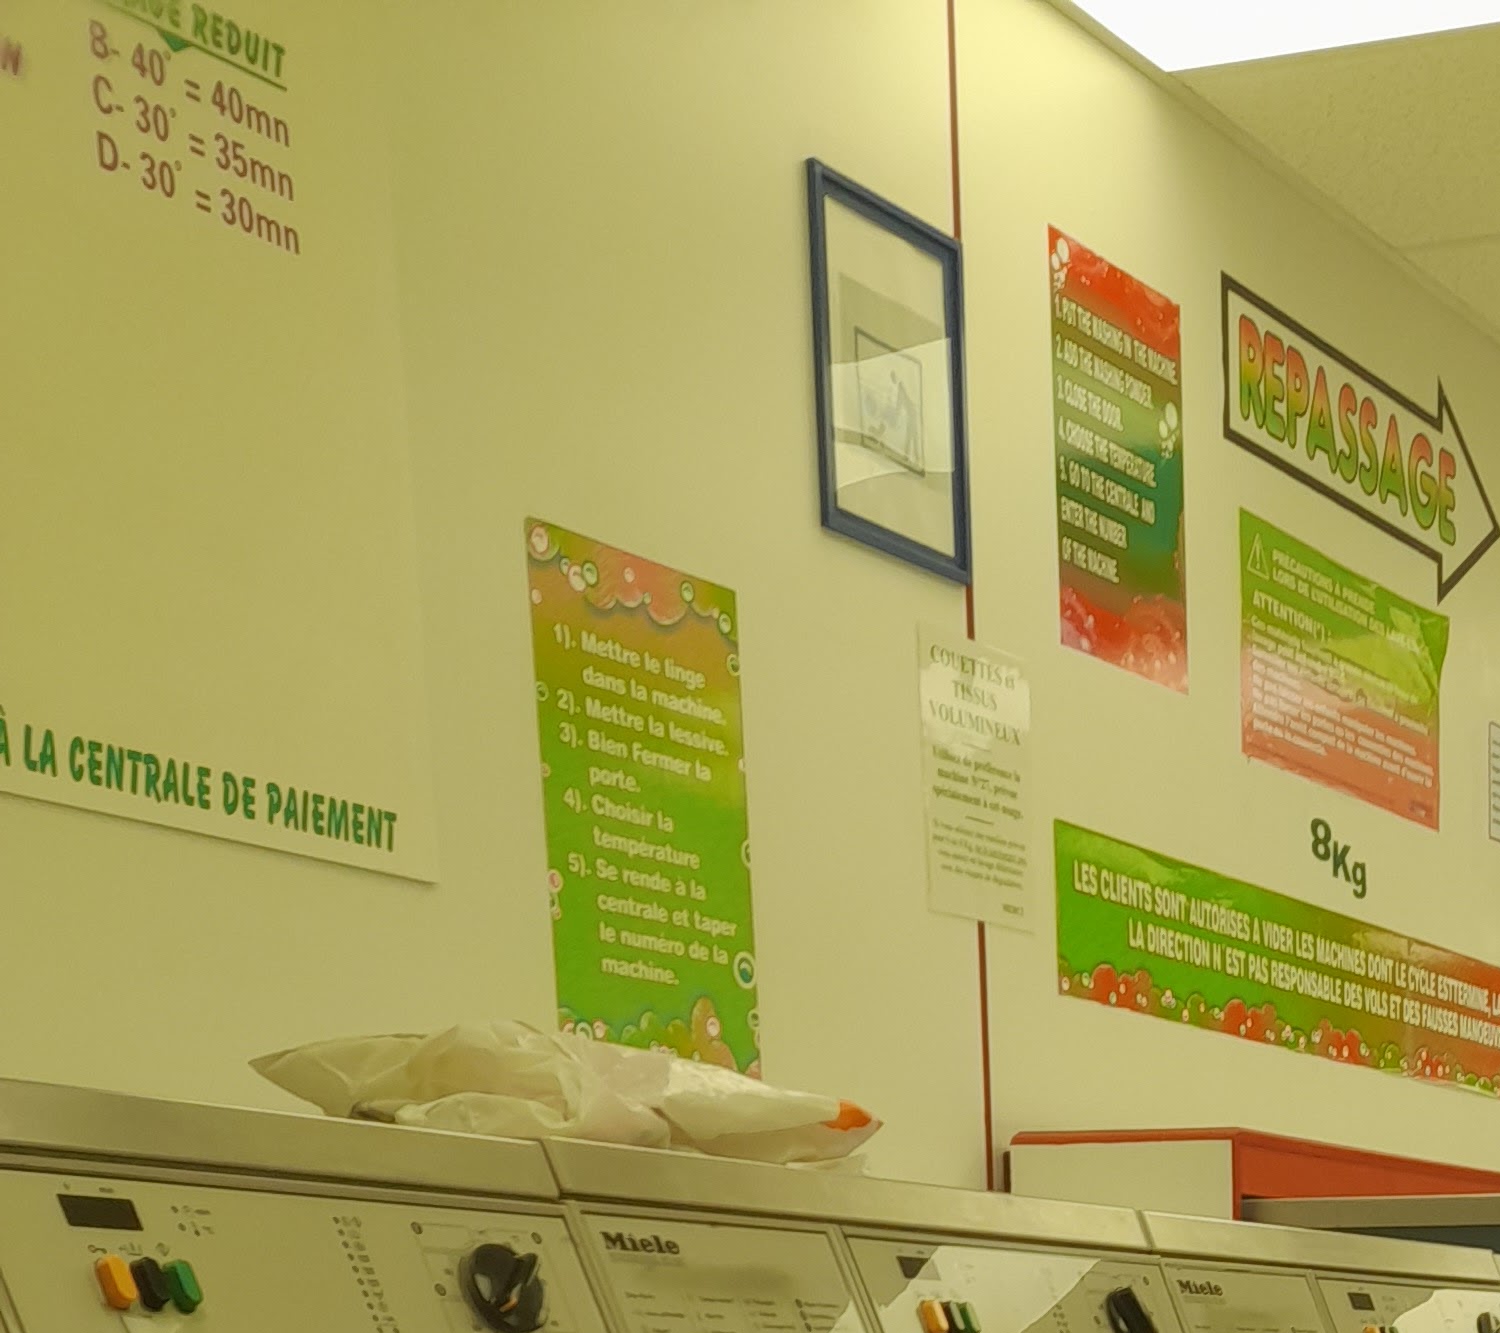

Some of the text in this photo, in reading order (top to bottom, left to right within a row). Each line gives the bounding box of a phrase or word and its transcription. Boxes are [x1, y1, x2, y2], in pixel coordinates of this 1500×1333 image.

[192, 3, 285, 77] REDUIT
[211, 80, 289, 147] 40mn
[214, 132, 294, 201] 35mn
[220, 188, 300, 254] 30mn
[1239, 313, 1456, 547] REPASSAGE
[581, 630, 641, 668] Mettre
[644, 651, 661, 674] le
[664, 658, 706, 691] linge
[582, 665, 727, 726] dans la machine.
[929, 699, 1021, 746] VOLUMINEUX
[585, 696, 644, 732] Mettre
[647, 715, 664, 738] la
[668, 721, 729, 756] lessive.
[587, 729, 628, 759] Bien
[695, 759, 712, 783] la
[23, 724, 397, 853] LA CENTRALE DE PAIEMENT
[589, 766, 641, 794] porte.
[591, 794, 653, 827] Choisir
[657, 811, 674, 832] la
[593, 825, 700, 870] température
[1310, 817, 1367, 899] 8Kg
[595, 858, 618, 881] Se
[690, 879, 707, 902] la
[597, 893, 737, 938] centrale et taper
[598, 921, 729, 965] le numéro de la
[1073, 859, 1098, 897] LES
[1100, 868, 1152, 912] CLIENTS
[1154, 886, 1186, 922] SONT
[1189, 898, 1250, 942] AUTORISES
[1262, 920, 1294, 954] VIDER
[1295, 930, 1316, 961] LES
[1316, 938, 1366, 977] MACHINES
[1367, 953, 1394, 984] DONT
[1395, 961, 1407, 989] LE
[1408, 964, 1436, 997] CYCLE
[601, 957, 680, 986] machine.
[1128, 917, 1144, 951] LA
[1148, 922, 1210, 969] DIRECTION
[1249, 953, 1268, 985] PAS
[1271, 959, 1341, 1006] RESPONSABLE
[1344, 980, 1363, 1010] DES
[1364, 987, 1387, 1017] VOLS
[1389, 994, 1401, 1020] ET
[1403, 997, 1421, 1027] DES
[1422, 1003, 1459, 1037] FAUSSES
[601, 1231, 680, 1255] Miele
[1177, 1279, 1223, 1297] Miele
